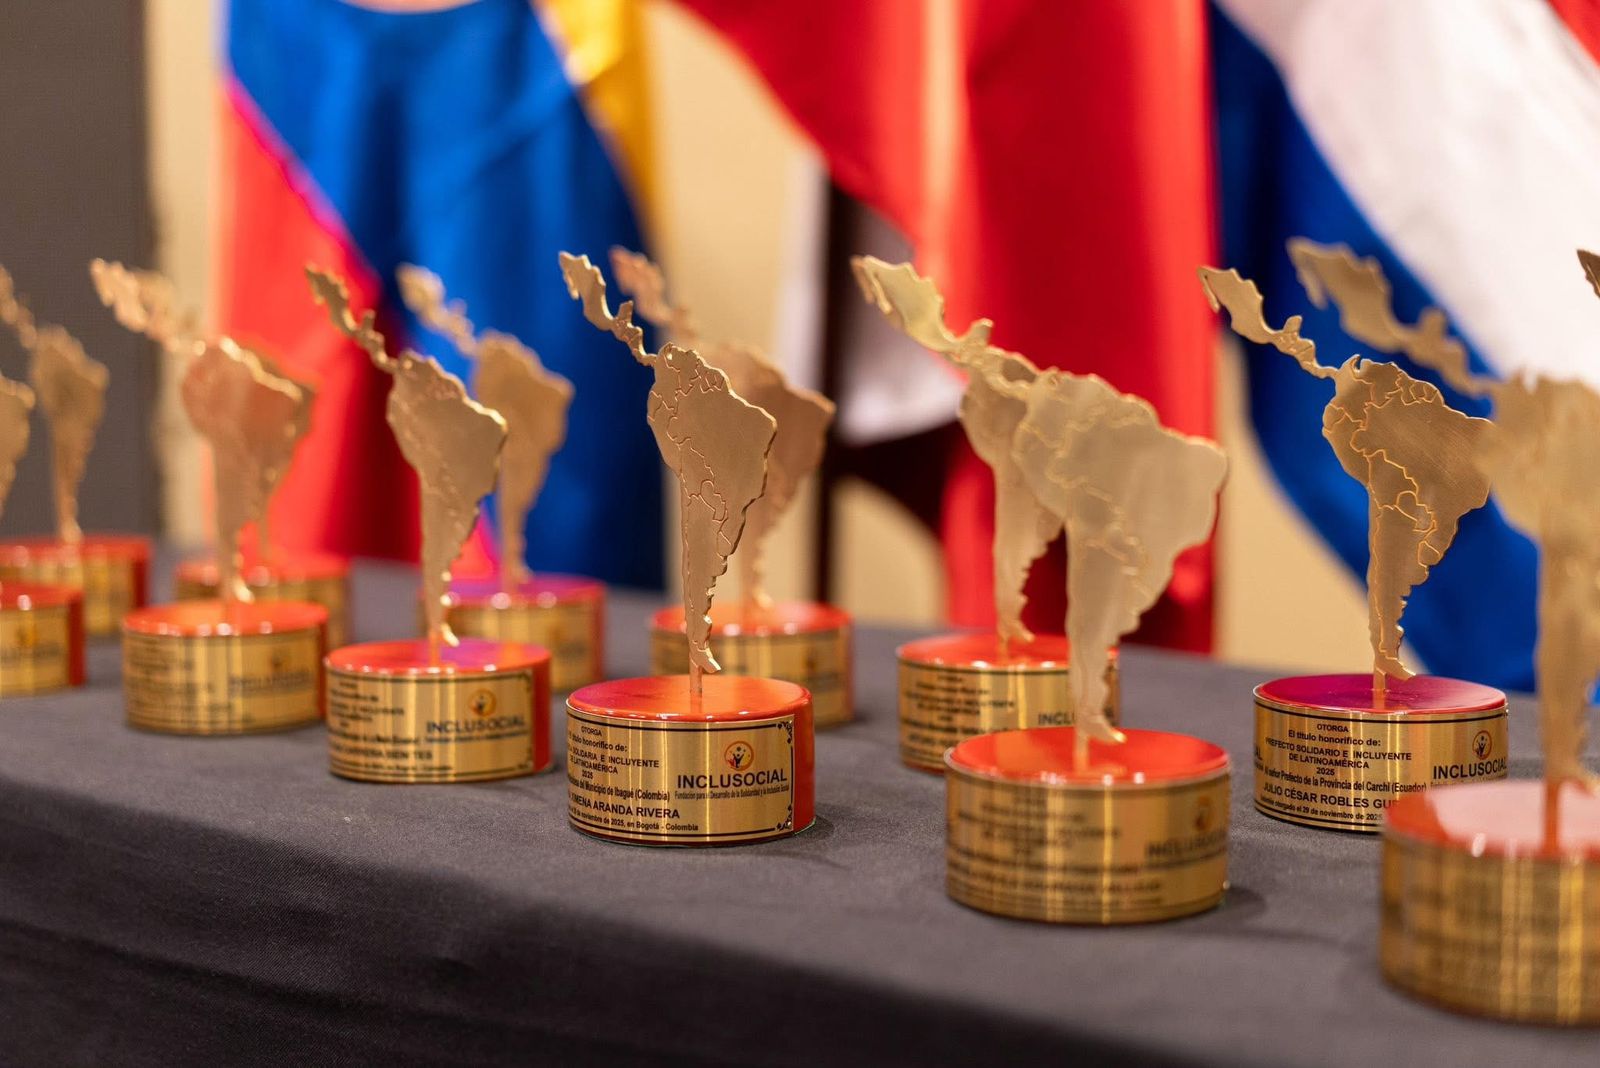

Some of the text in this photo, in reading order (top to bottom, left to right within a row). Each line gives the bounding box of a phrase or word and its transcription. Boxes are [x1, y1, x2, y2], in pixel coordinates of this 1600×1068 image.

[581, 725, 602, 737] OTORGA
[1316, 723, 1349, 733] OTORGA
[1288, 729, 1295, 738] El
[1366, 738, 1381, 747] de:
[1296, 744, 1340, 757] SOLIDARIO
[1342, 750, 1349, 758] E
[1353, 750, 1412, 761] INCLUYENTE
[600, 754, 606, 762] E
[608, 755, 660, 768] INCLUYENTE
[1288, 753, 1370, 769] DE LATINOAMÉRICA
[1433, 757, 1507, 780] INCLUSOCIAL
[582, 769, 594, 780] 2025
[677, 768, 788, 789] INCLUSOCIAL
[1316, 766, 1336, 777] 2025
[1303, 776, 1312, 785] de
[1312, 776, 1319, 786] la
[1320, 777, 1352, 790] Provincia
[1353, 780, 1365, 791] del
[1366, 781, 1391, 793] Carchi
[1391, 782, 1427, 795] (Ecuador)
[607, 786, 614, 796] de
[635, 789, 670, 803] (Colombia)
[1264, 782, 1283, 796] JULIO
[1284, 786, 1318, 804] CÉSAR
[1320, 794, 1370, 808] ROBLES
[593, 800, 633, 816] ARANDA
[635, 807, 680, 819] RIVERA
[1320, 810, 1354, 819] noviembre
[665, 823, 699, 831] Colombia
